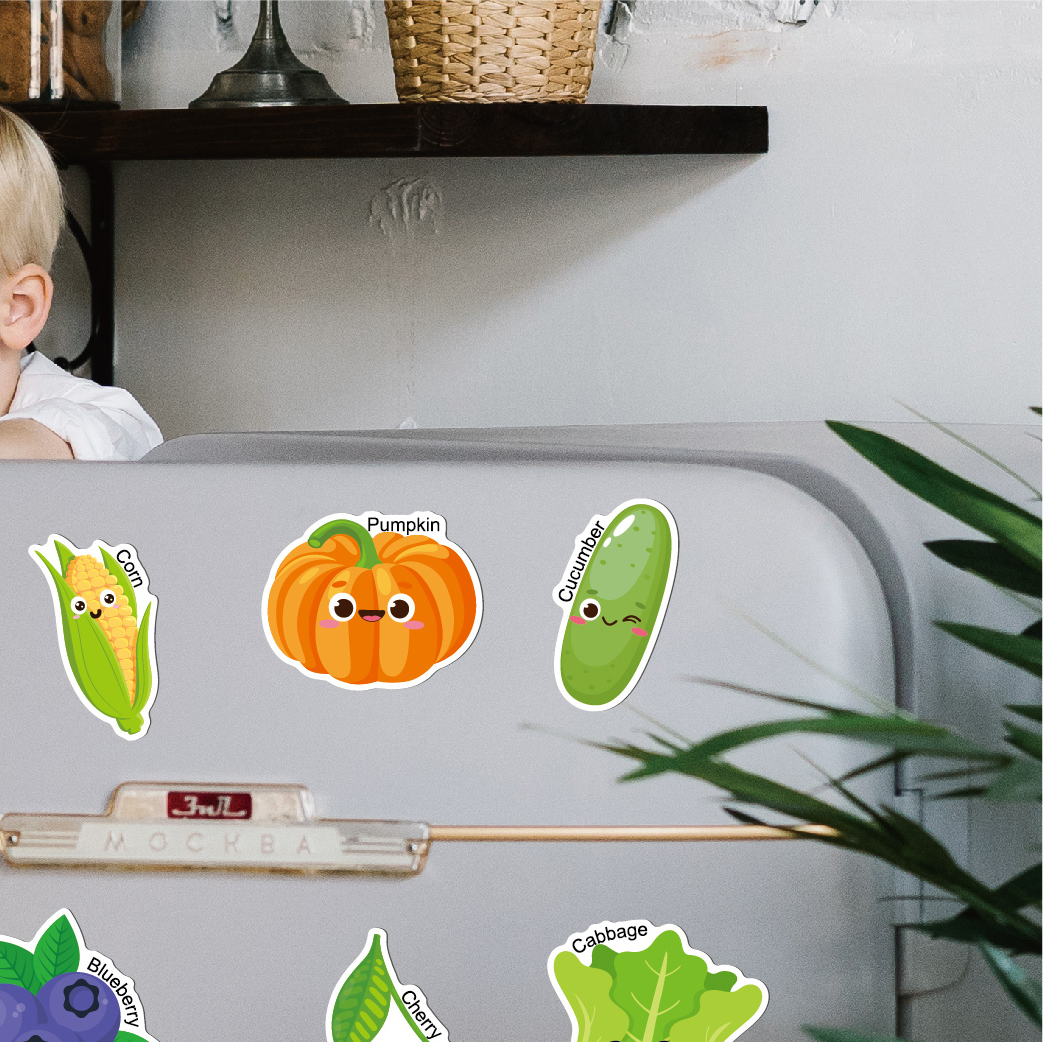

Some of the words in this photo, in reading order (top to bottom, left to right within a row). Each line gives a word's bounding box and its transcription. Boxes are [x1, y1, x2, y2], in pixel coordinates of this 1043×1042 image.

[368, 517, 440, 536] Pumpkin
[116, 549, 143, 588] Corn
[559, 520, 605, 603] Cucumber
[572, 925, 648, 954] Cabbage
[86, 956, 139, 1028] Blueberry
[401, 990, 442, 1040] Cherry
